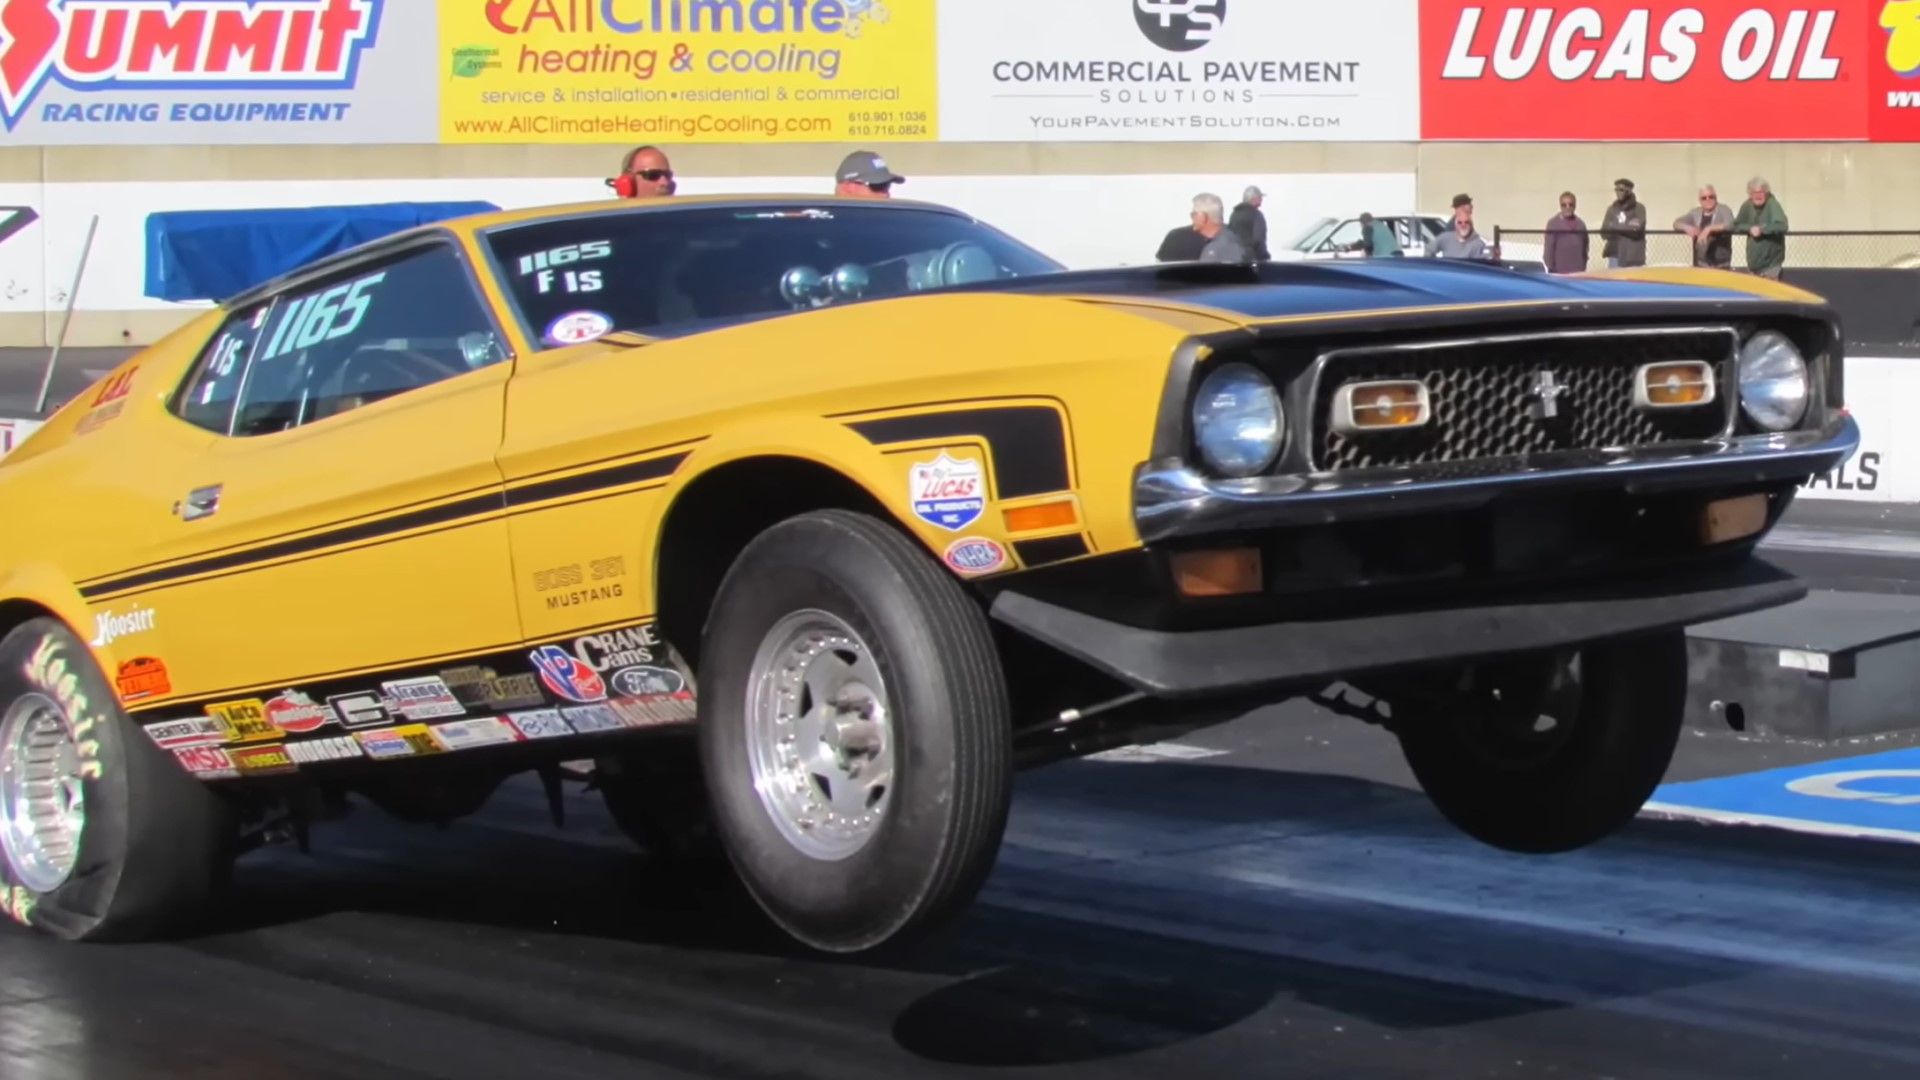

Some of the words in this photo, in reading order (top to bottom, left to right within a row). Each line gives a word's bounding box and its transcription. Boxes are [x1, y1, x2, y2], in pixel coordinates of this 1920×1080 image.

[1441, 8, 1704, 82] LUCAS
[1721, 9, 1841, 81] OIL
[517, 44, 657, 79] heating
[669, 43, 694, 74] &
[707, 43, 841, 79] cooling
[993, 62, 1191, 82] COMMERCIAL
[1204, 62, 1360, 82] PAVEMENT
[481, 90, 545, 103] service
[552, 89, 564, 102] &
[777, 87, 788, 100] &
[795, 86, 899, 101] commercial
[1100, 90, 1254, 103] SOLUTIONS
[42, 103, 160, 122] RACING
[169, 103, 350, 122] EQUIPMENT
[848, 111, 927, 122] 610.901.1036
[454, 113, 832, 137] www.AllClimateHeatingCooling.com
[848, 125, 927, 136] 610.716.0824
[519, 239, 612, 276] 1165
[261, 271, 387, 361] 1165
[921, 478, 977, 499] LUCAS
[953, 543, 997, 567] NHRA
[533, 563, 583, 592] BOSS
[546, 584, 623, 611] MUSTANG
[88, 608, 155, 647] Hoosier
[574, 625, 661, 671] CRANE
[151, 724, 194, 738] CENTER
